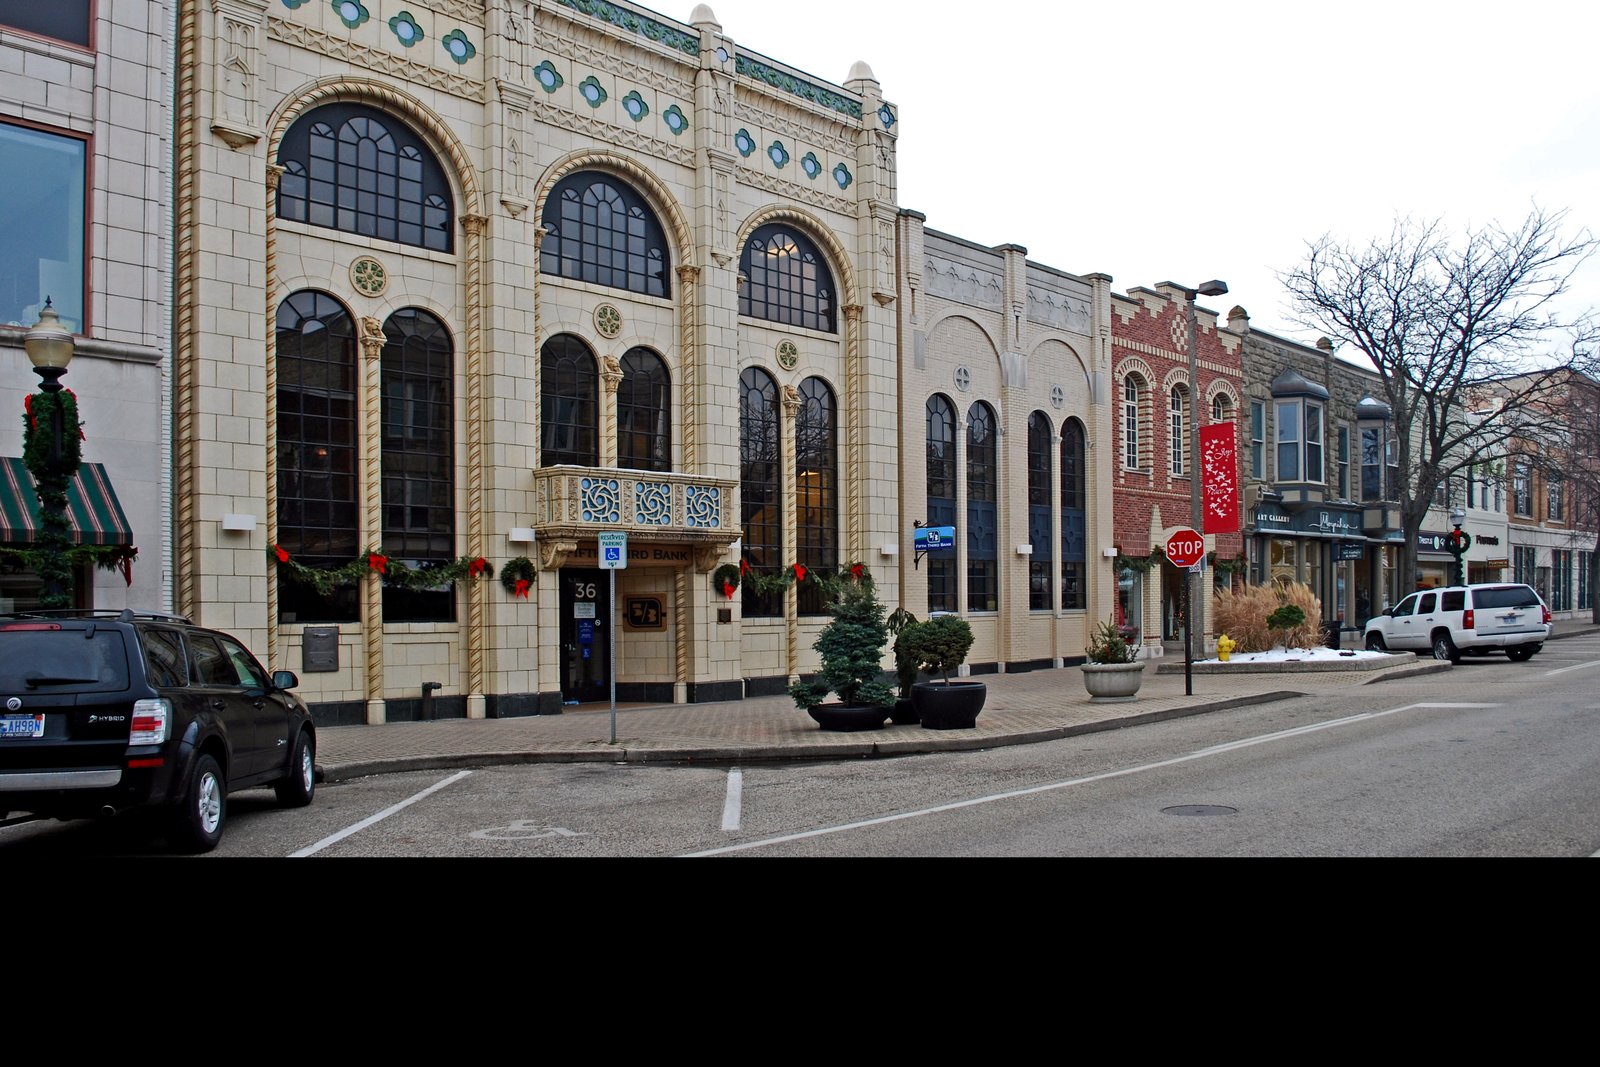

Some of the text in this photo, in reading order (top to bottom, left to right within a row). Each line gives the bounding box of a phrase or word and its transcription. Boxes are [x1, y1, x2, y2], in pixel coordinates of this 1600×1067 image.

[1257, 513, 1268, 521] ART
[1168, 540, 1203, 556] STOP
[653, 549, 689, 561] BANK
[575, 582, 596, 599] 36
[8, 720, 41, 732] AH98N
